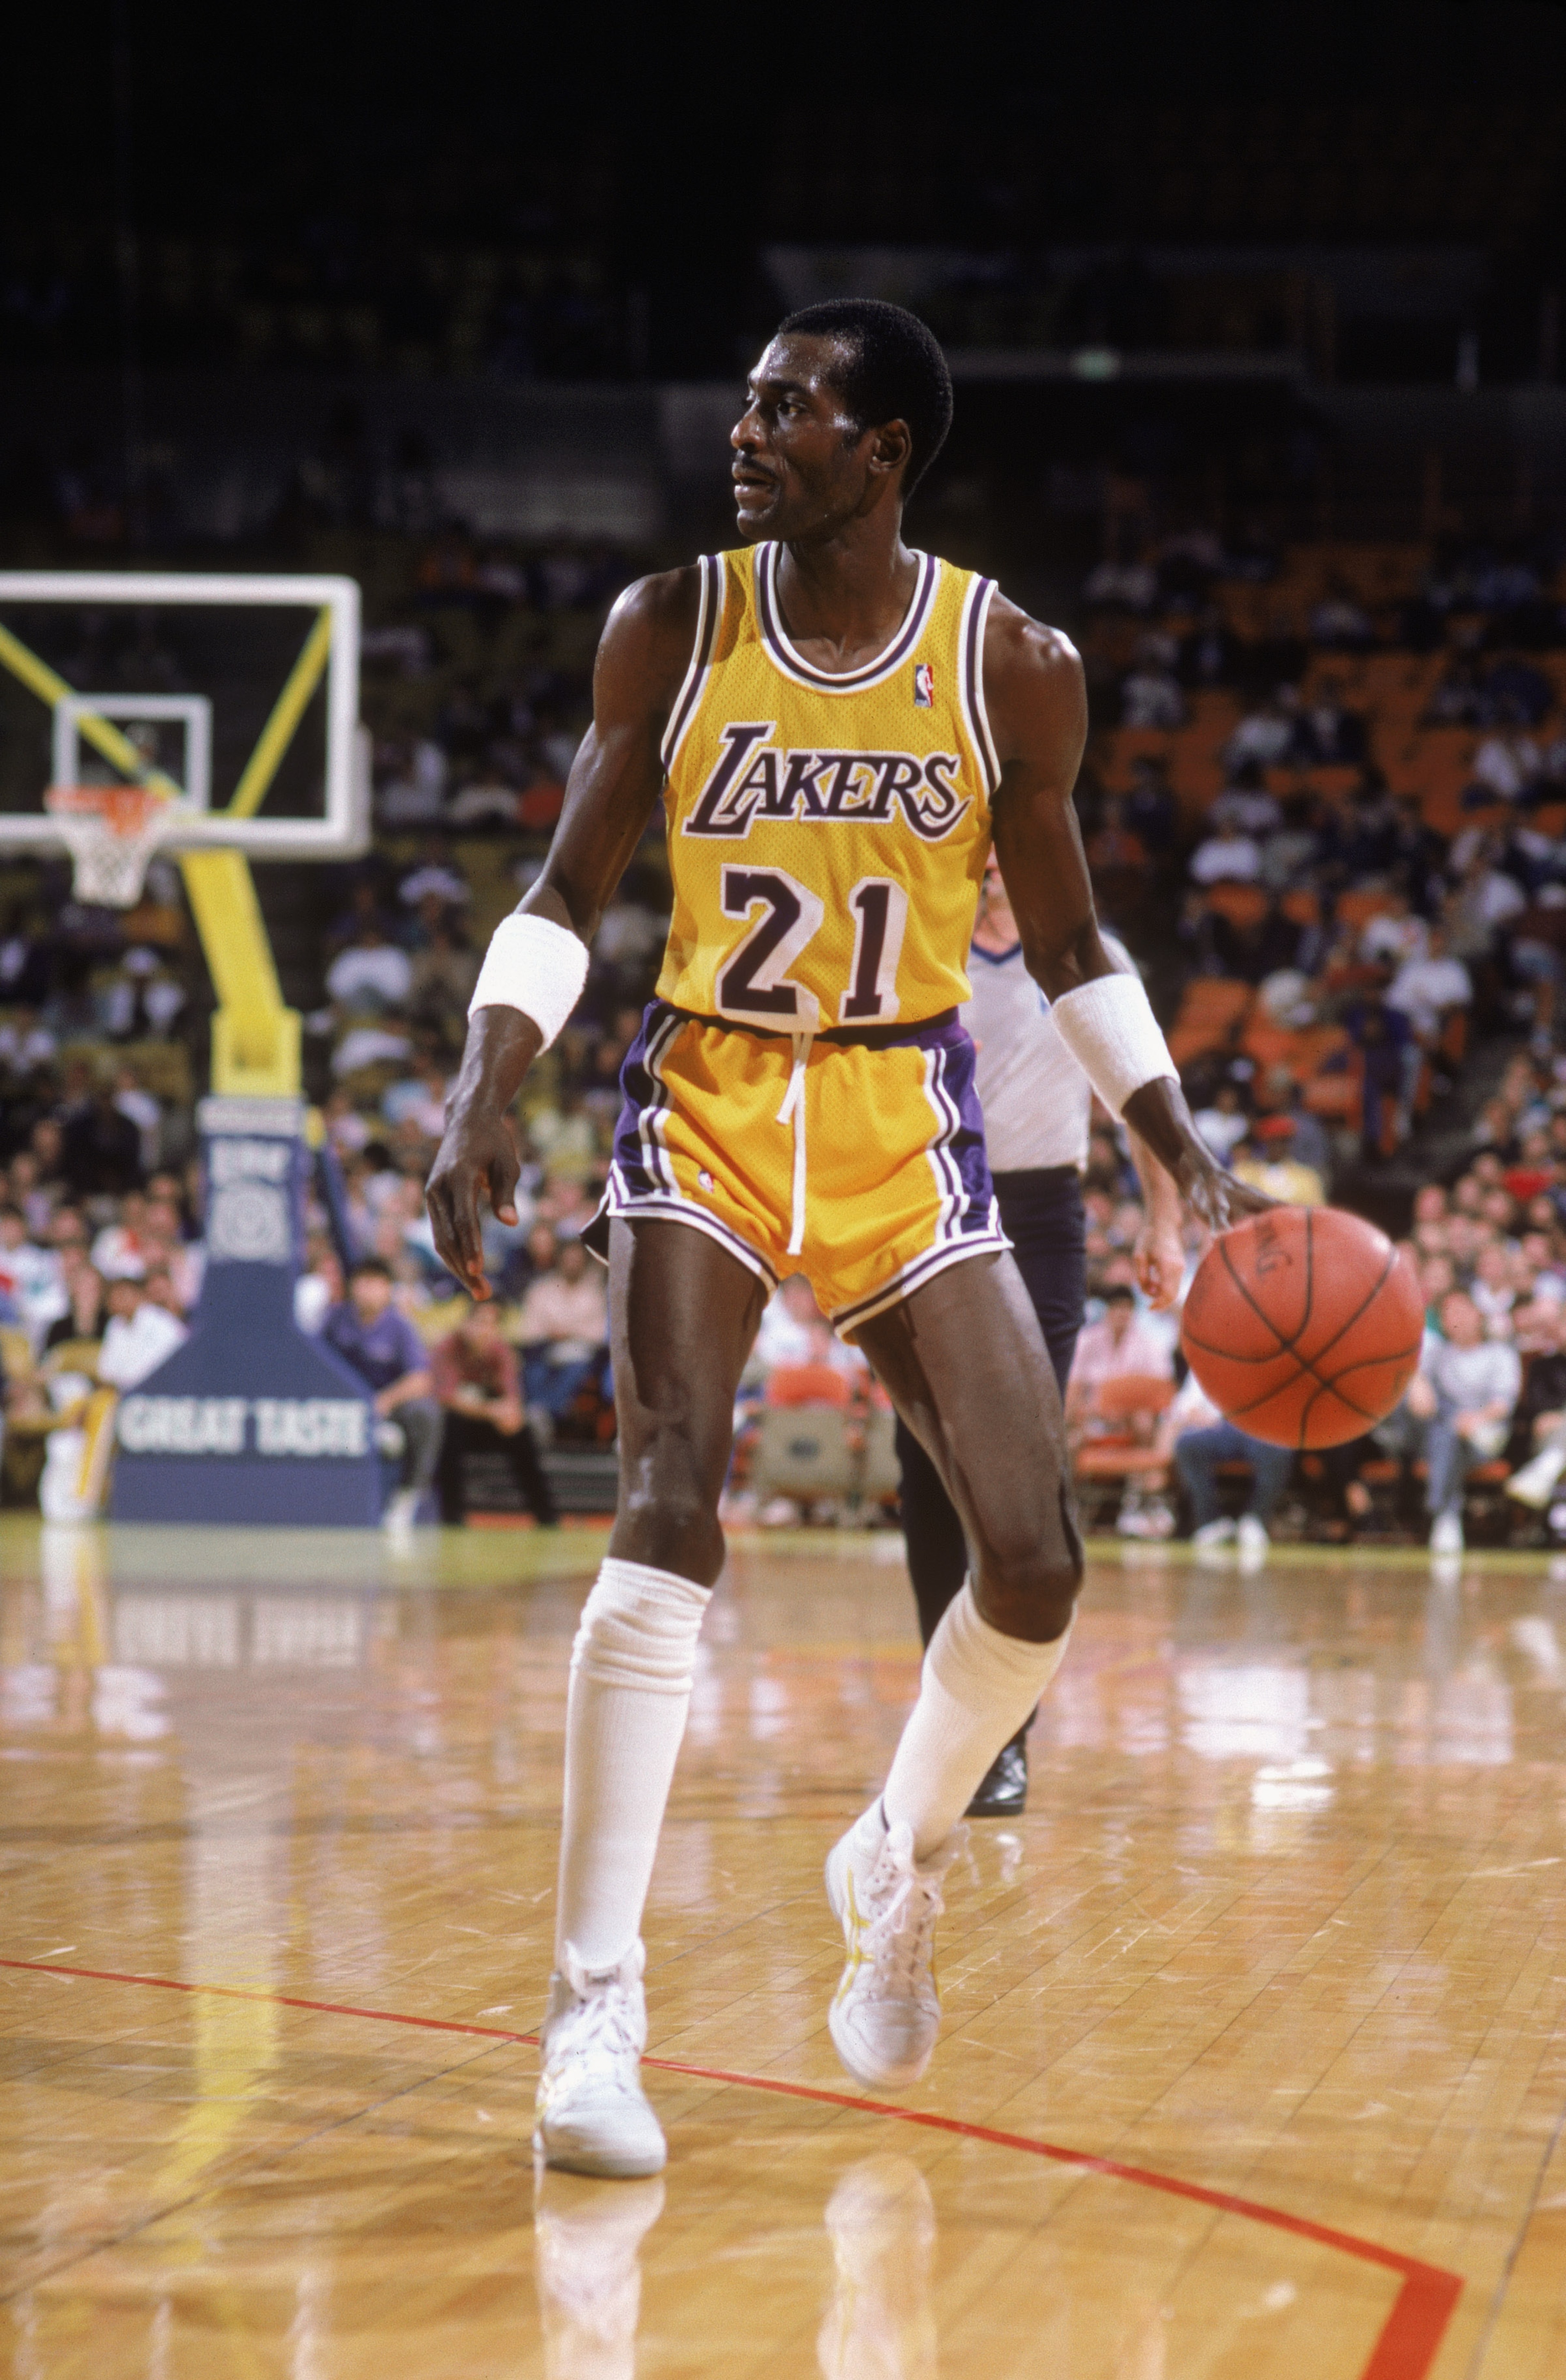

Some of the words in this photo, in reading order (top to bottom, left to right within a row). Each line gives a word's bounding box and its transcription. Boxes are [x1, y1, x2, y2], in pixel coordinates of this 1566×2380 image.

[681, 721, 974, 842] LAKERS
[717, 864, 908, 1032] 21
[117, 1394, 246, 1454] GREAT
[254, 1396, 368, 1457] TASTE
